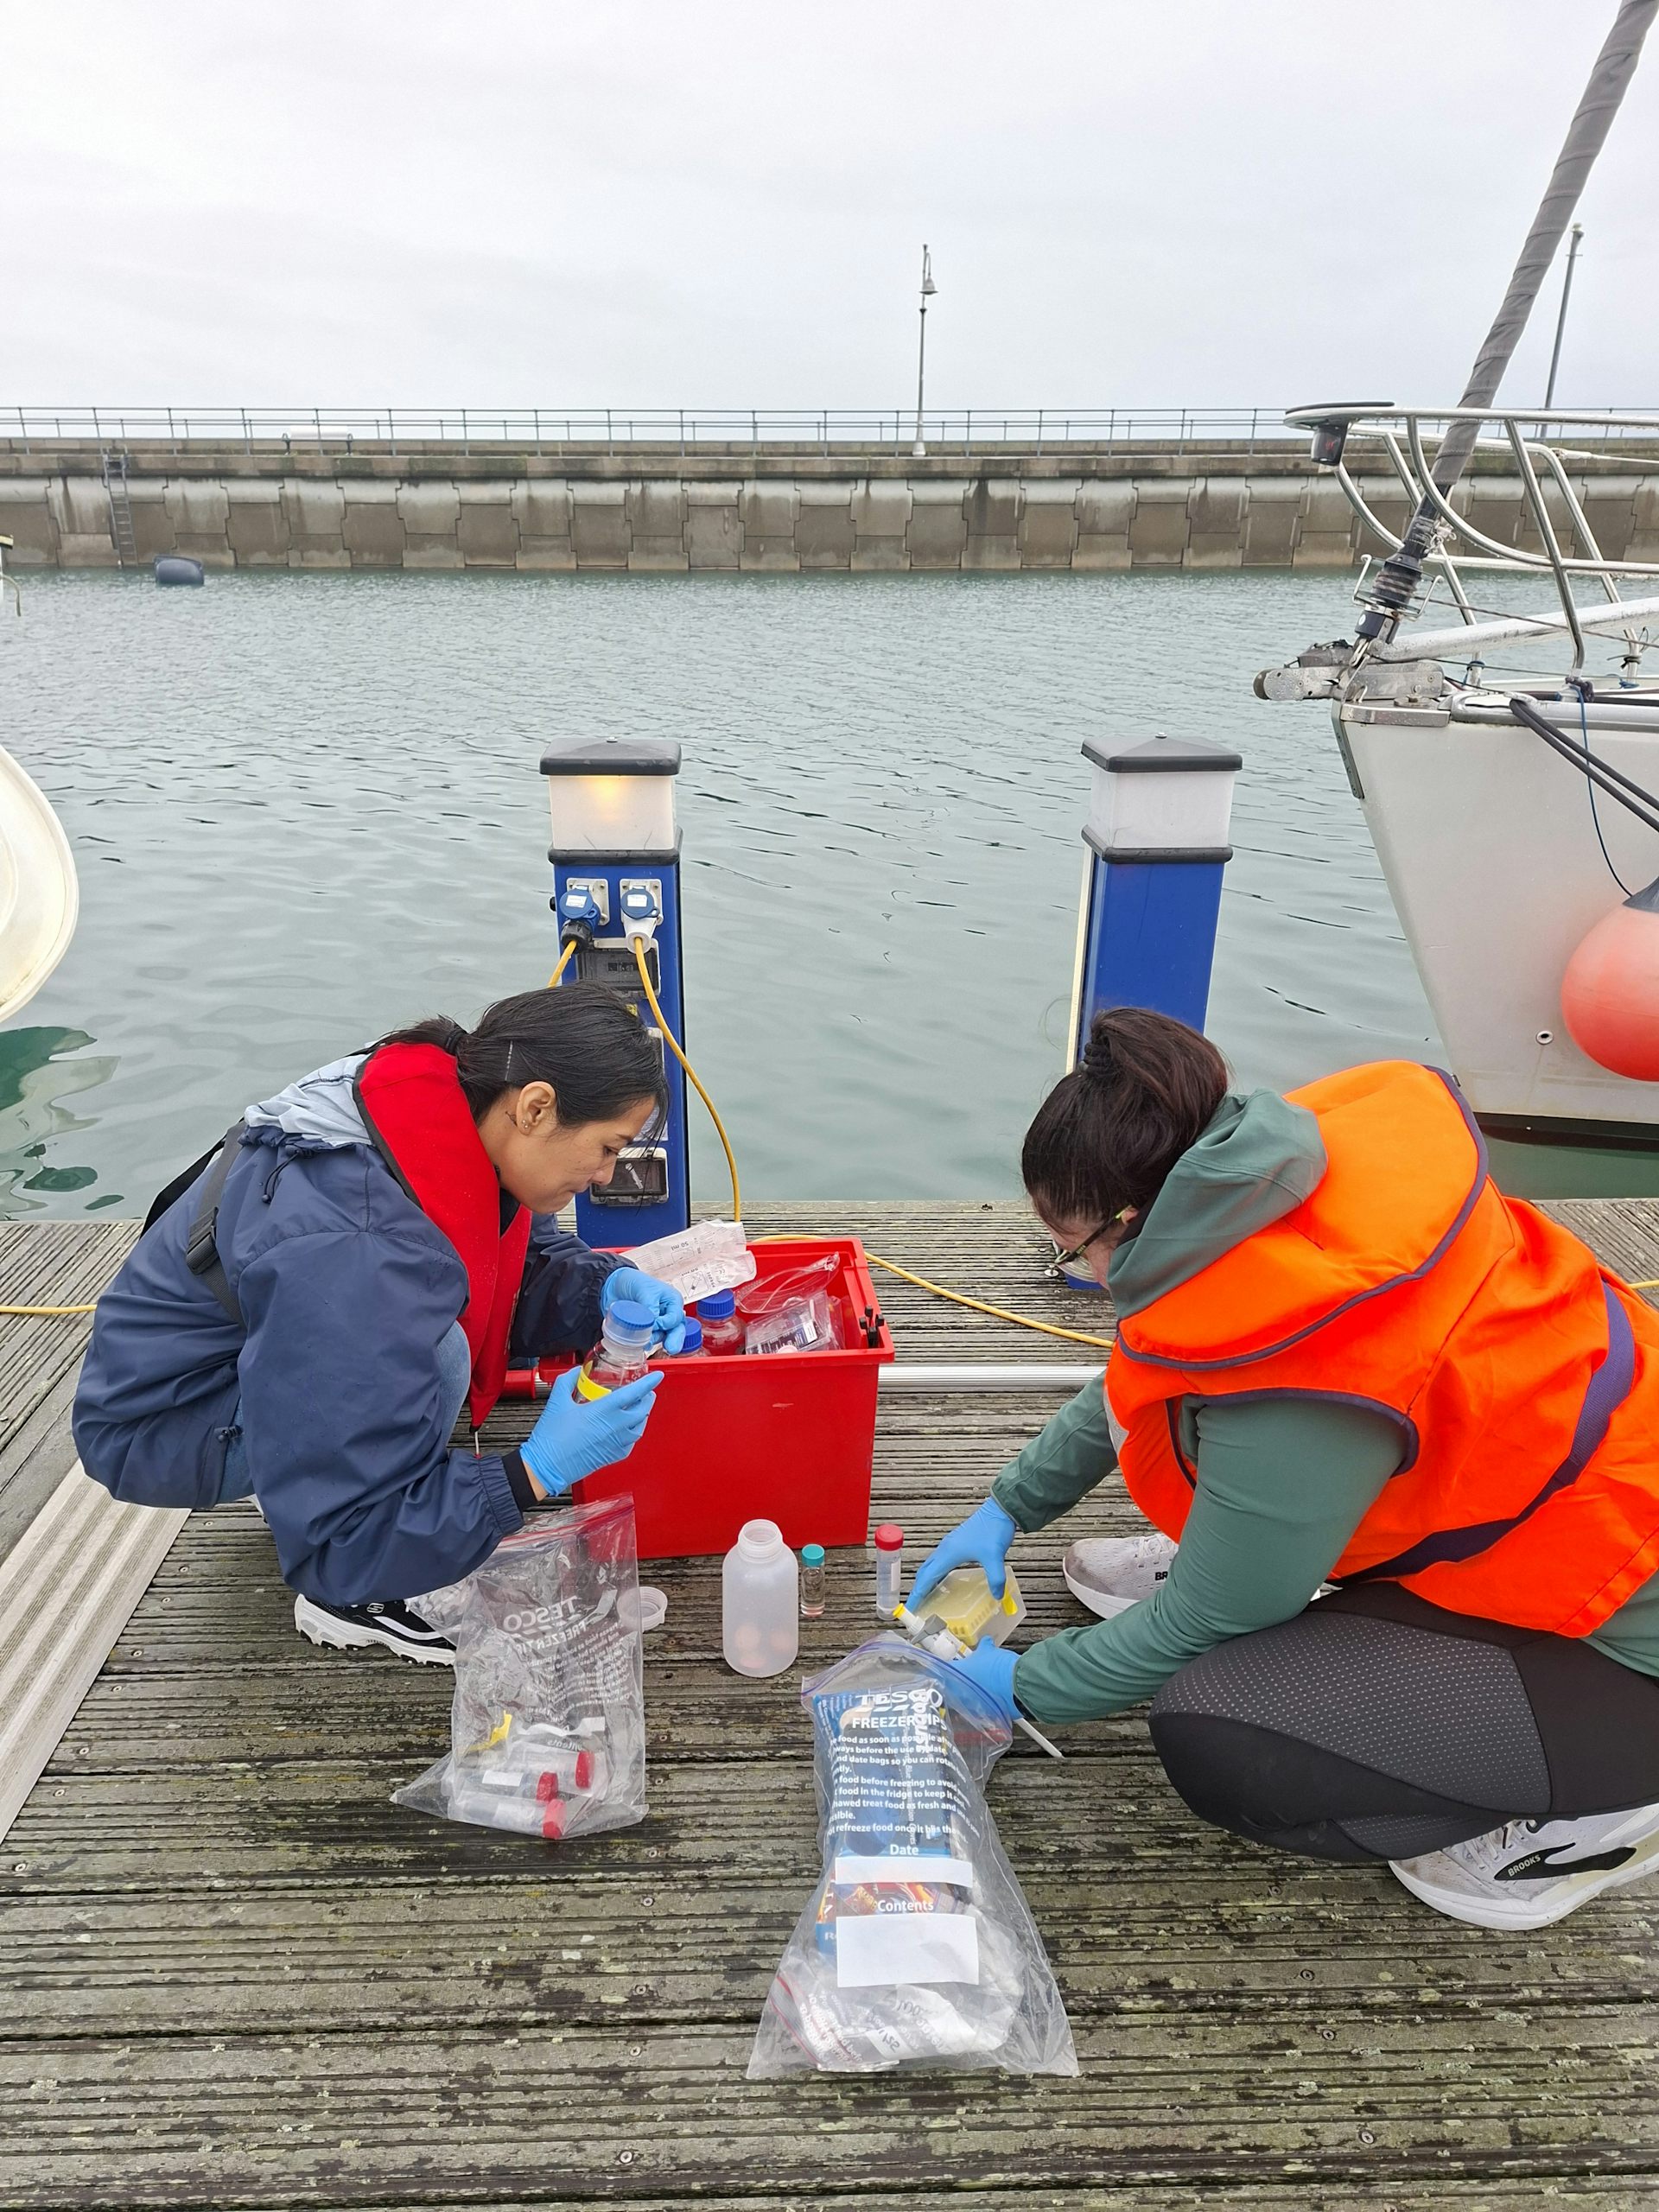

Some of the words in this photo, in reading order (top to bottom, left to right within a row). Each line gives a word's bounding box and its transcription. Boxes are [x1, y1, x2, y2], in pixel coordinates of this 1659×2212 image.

[855, 1688, 944, 1707] TESCO
[853, 1713, 916, 1728] FREEZER
[838, 1735, 857, 1744] food
[869, 1757, 889, 1765] bags
[902, 1758, 918, 1766] you
[861, 1777, 888, 1786] before
[890, 1778, 925, 1788] freezing
[839, 1786, 859, 1795] food
[871, 1788, 885, 1796] the
[925, 1789, 945, 1799] keep
[833, 1799, 861, 1808] hawed
[885, 1800, 905, 1809] food
[918, 1801, 939, 1809] fresh
[941, 1802, 957, 1812] and
[836, 1822, 871, 1832] refreeze
[873, 1822, 893, 1831] food
[890, 1843, 919, 1855] Date
[1507, 1853, 1541, 1877] BROOKS
[877, 1899, 934, 1912] Contents
